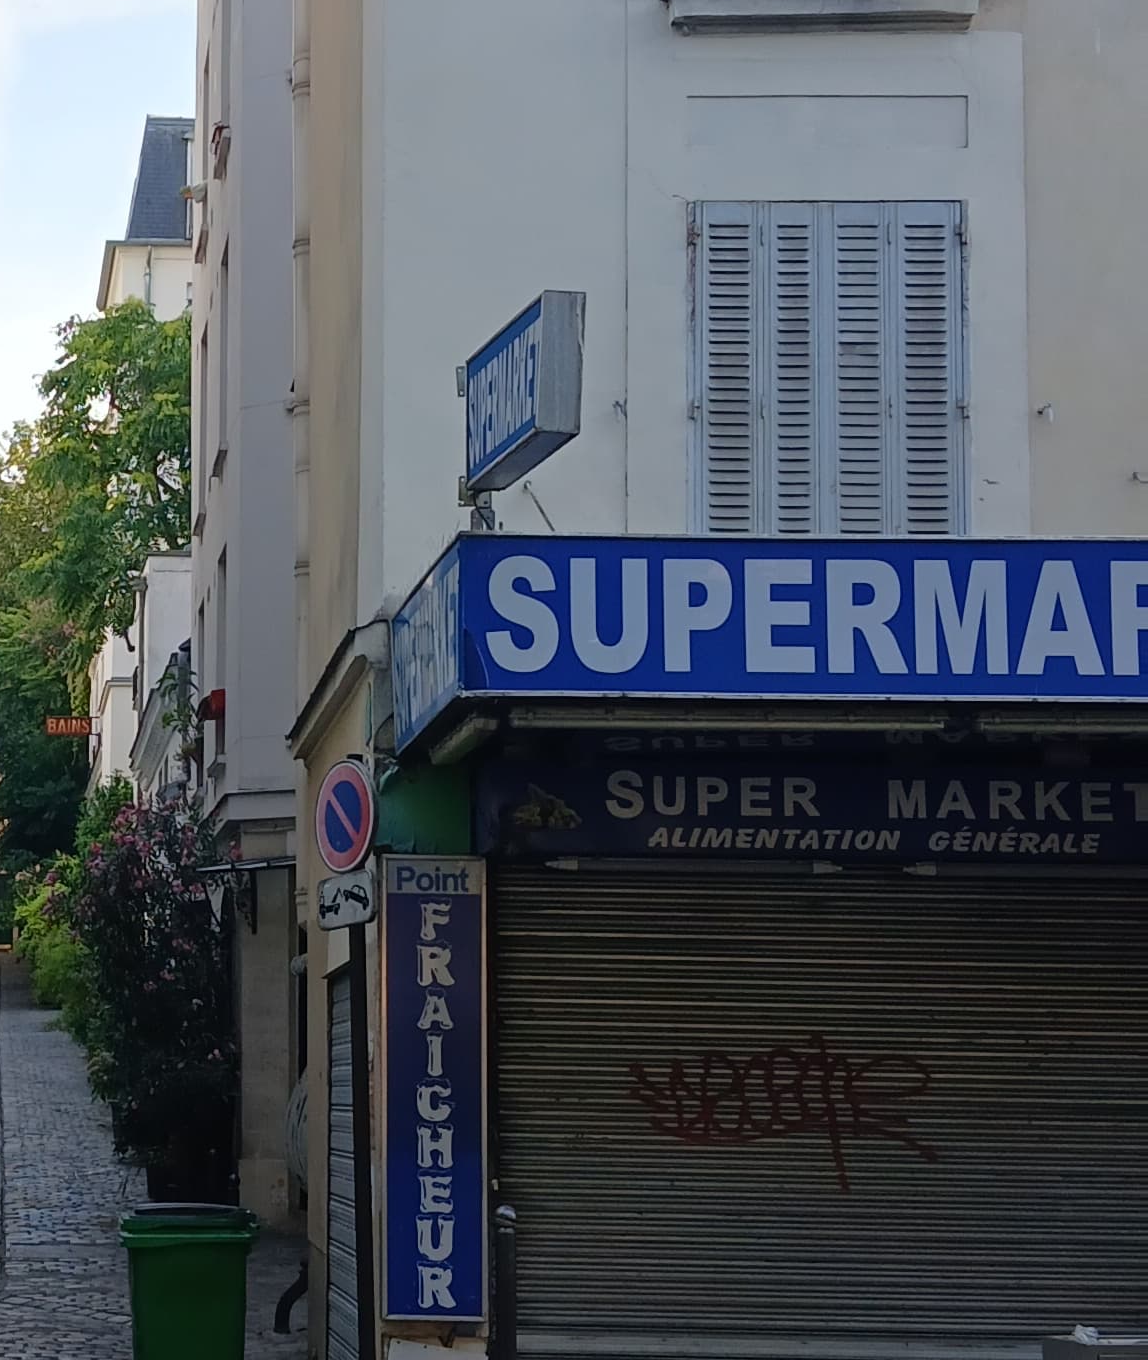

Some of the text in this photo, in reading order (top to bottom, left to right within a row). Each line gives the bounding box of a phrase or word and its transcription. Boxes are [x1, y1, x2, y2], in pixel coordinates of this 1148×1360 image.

[47, 717, 90, 734] BAINS
[605, 769, 1148, 822] SUPER MARKET
[647, 826, 1101, 854] ALIMENTATION GÉNÉRALE
[396, 866, 469, 892] Point
[415, 897, 457, 1310] FRAICHEUR
